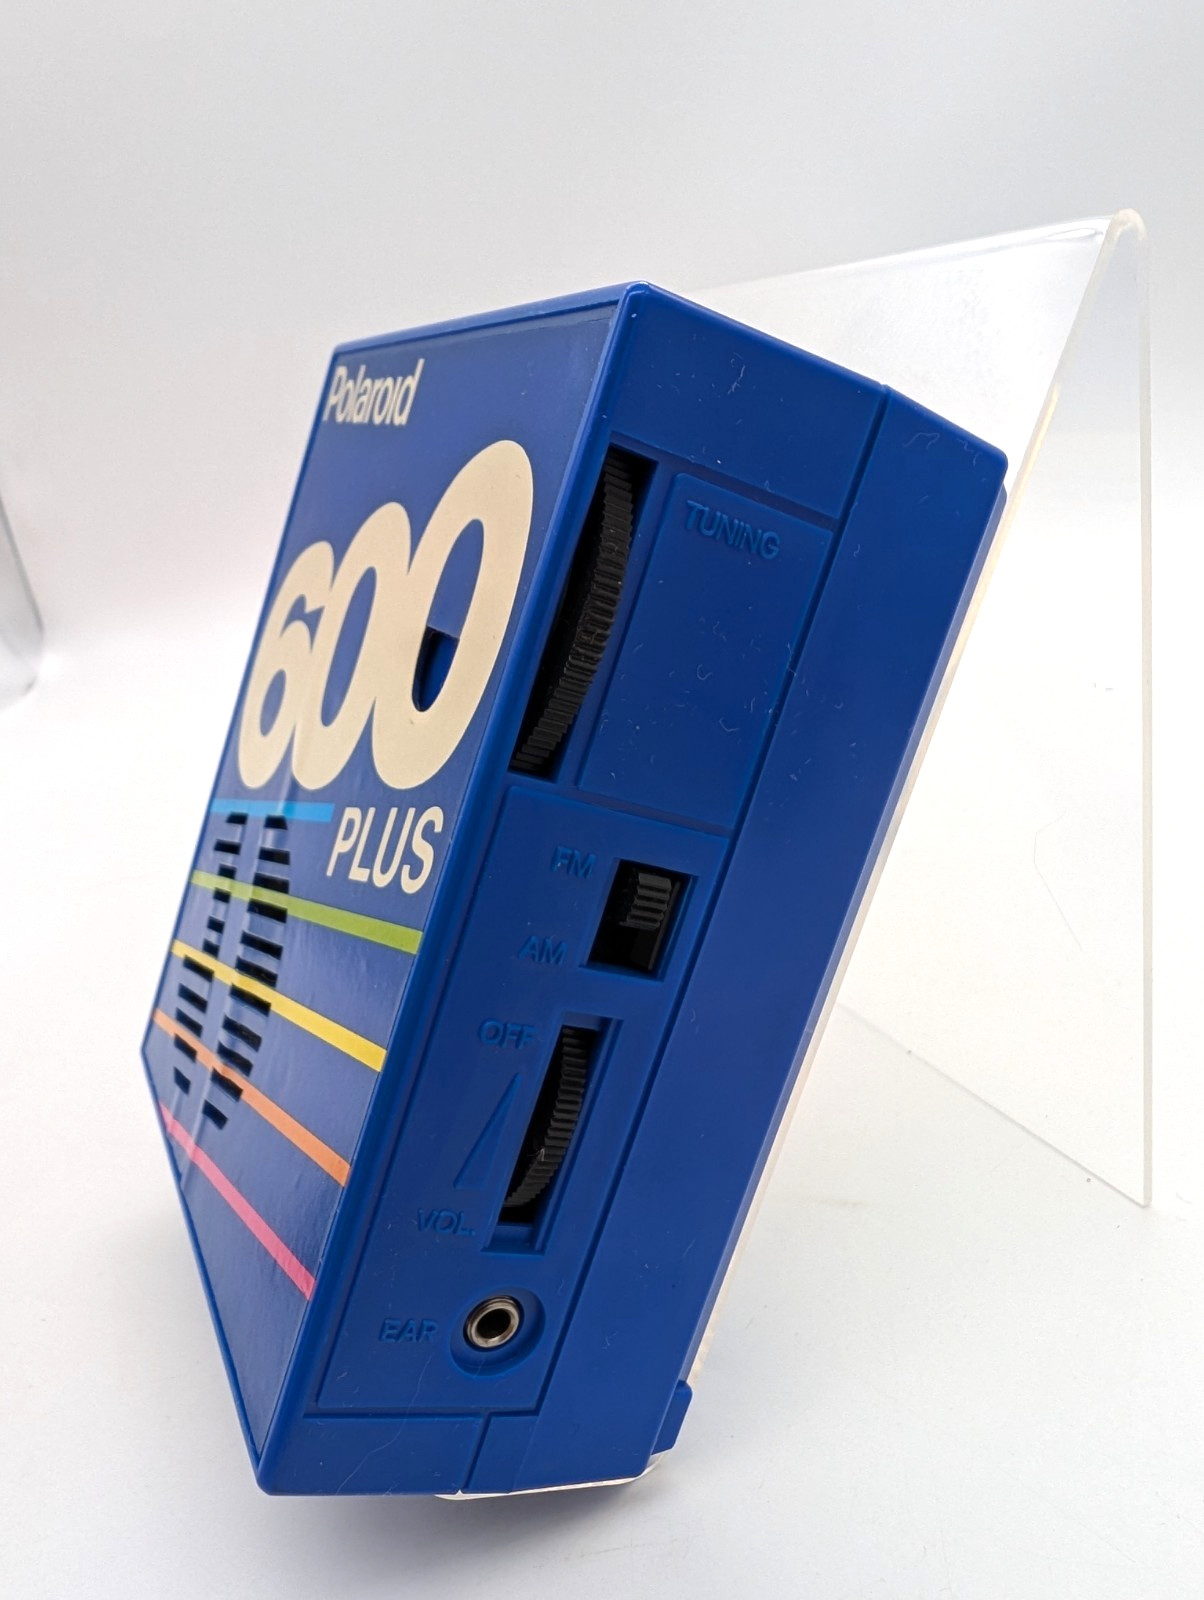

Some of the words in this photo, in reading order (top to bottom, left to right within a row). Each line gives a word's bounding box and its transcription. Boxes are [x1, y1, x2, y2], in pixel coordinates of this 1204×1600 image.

[323, 358, 425, 426] Polaroid
[686, 500, 781, 560] TUNING
[237, 440, 533, 790] 600
[326, 806, 444, 894] PLUS
[550, 845, 597, 879] FM
[516, 935, 568, 965] AM
[479, 1018, 538, 1049] OFF
[379, 1317, 439, 1343] EAR
